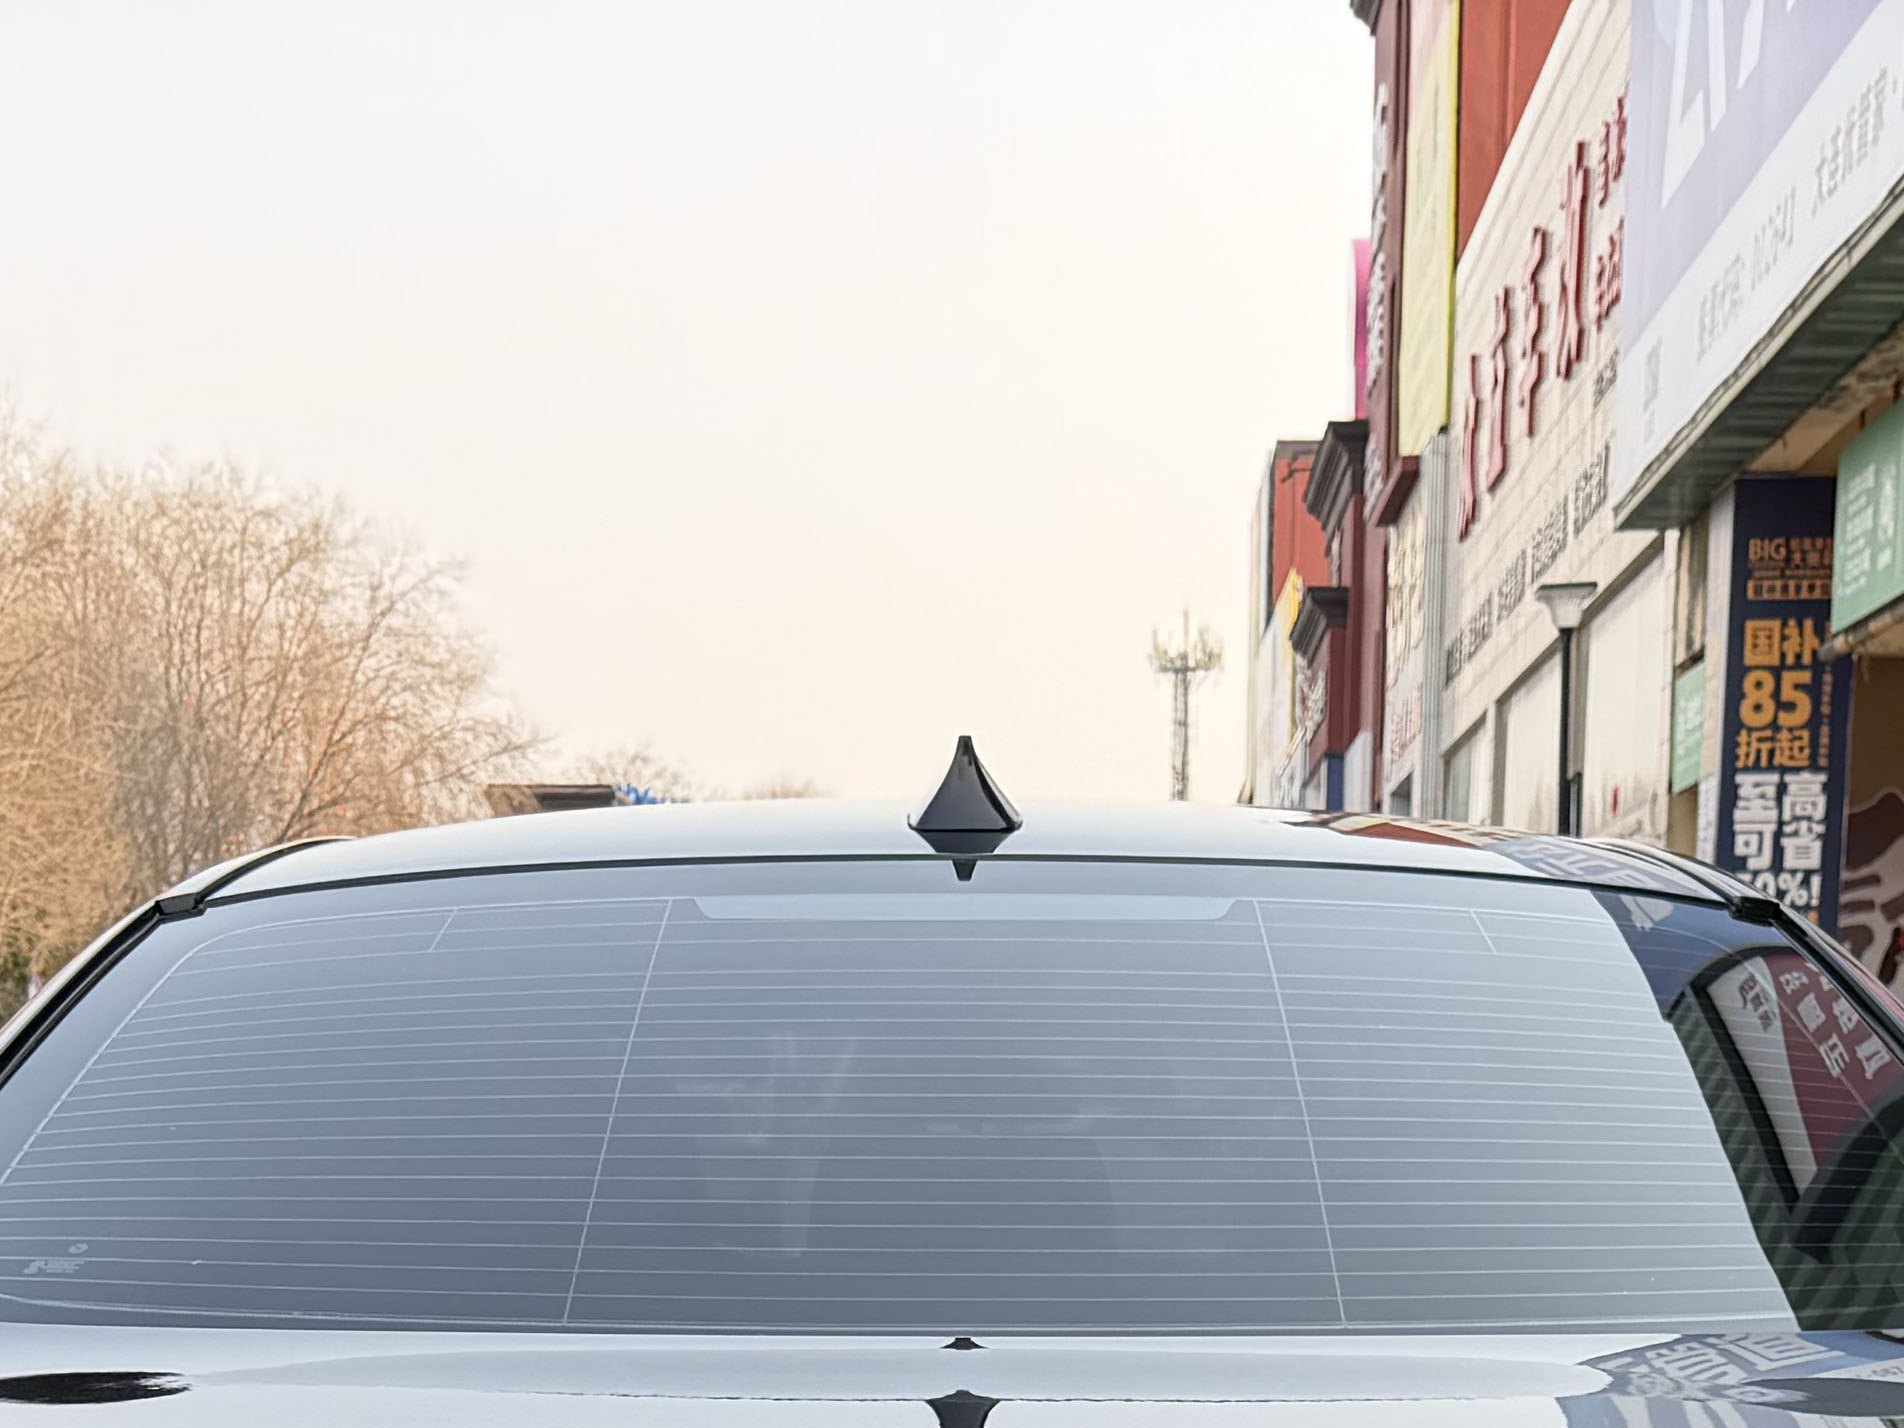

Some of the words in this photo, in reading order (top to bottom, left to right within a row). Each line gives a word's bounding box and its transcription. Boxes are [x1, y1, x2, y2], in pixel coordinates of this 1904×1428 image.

[1748, 538, 1787, 561] BIG
[1743, 618, 1819, 666] 国补
[1739, 668, 1812, 729] 85
[1735, 727, 1811, 768] 折起
